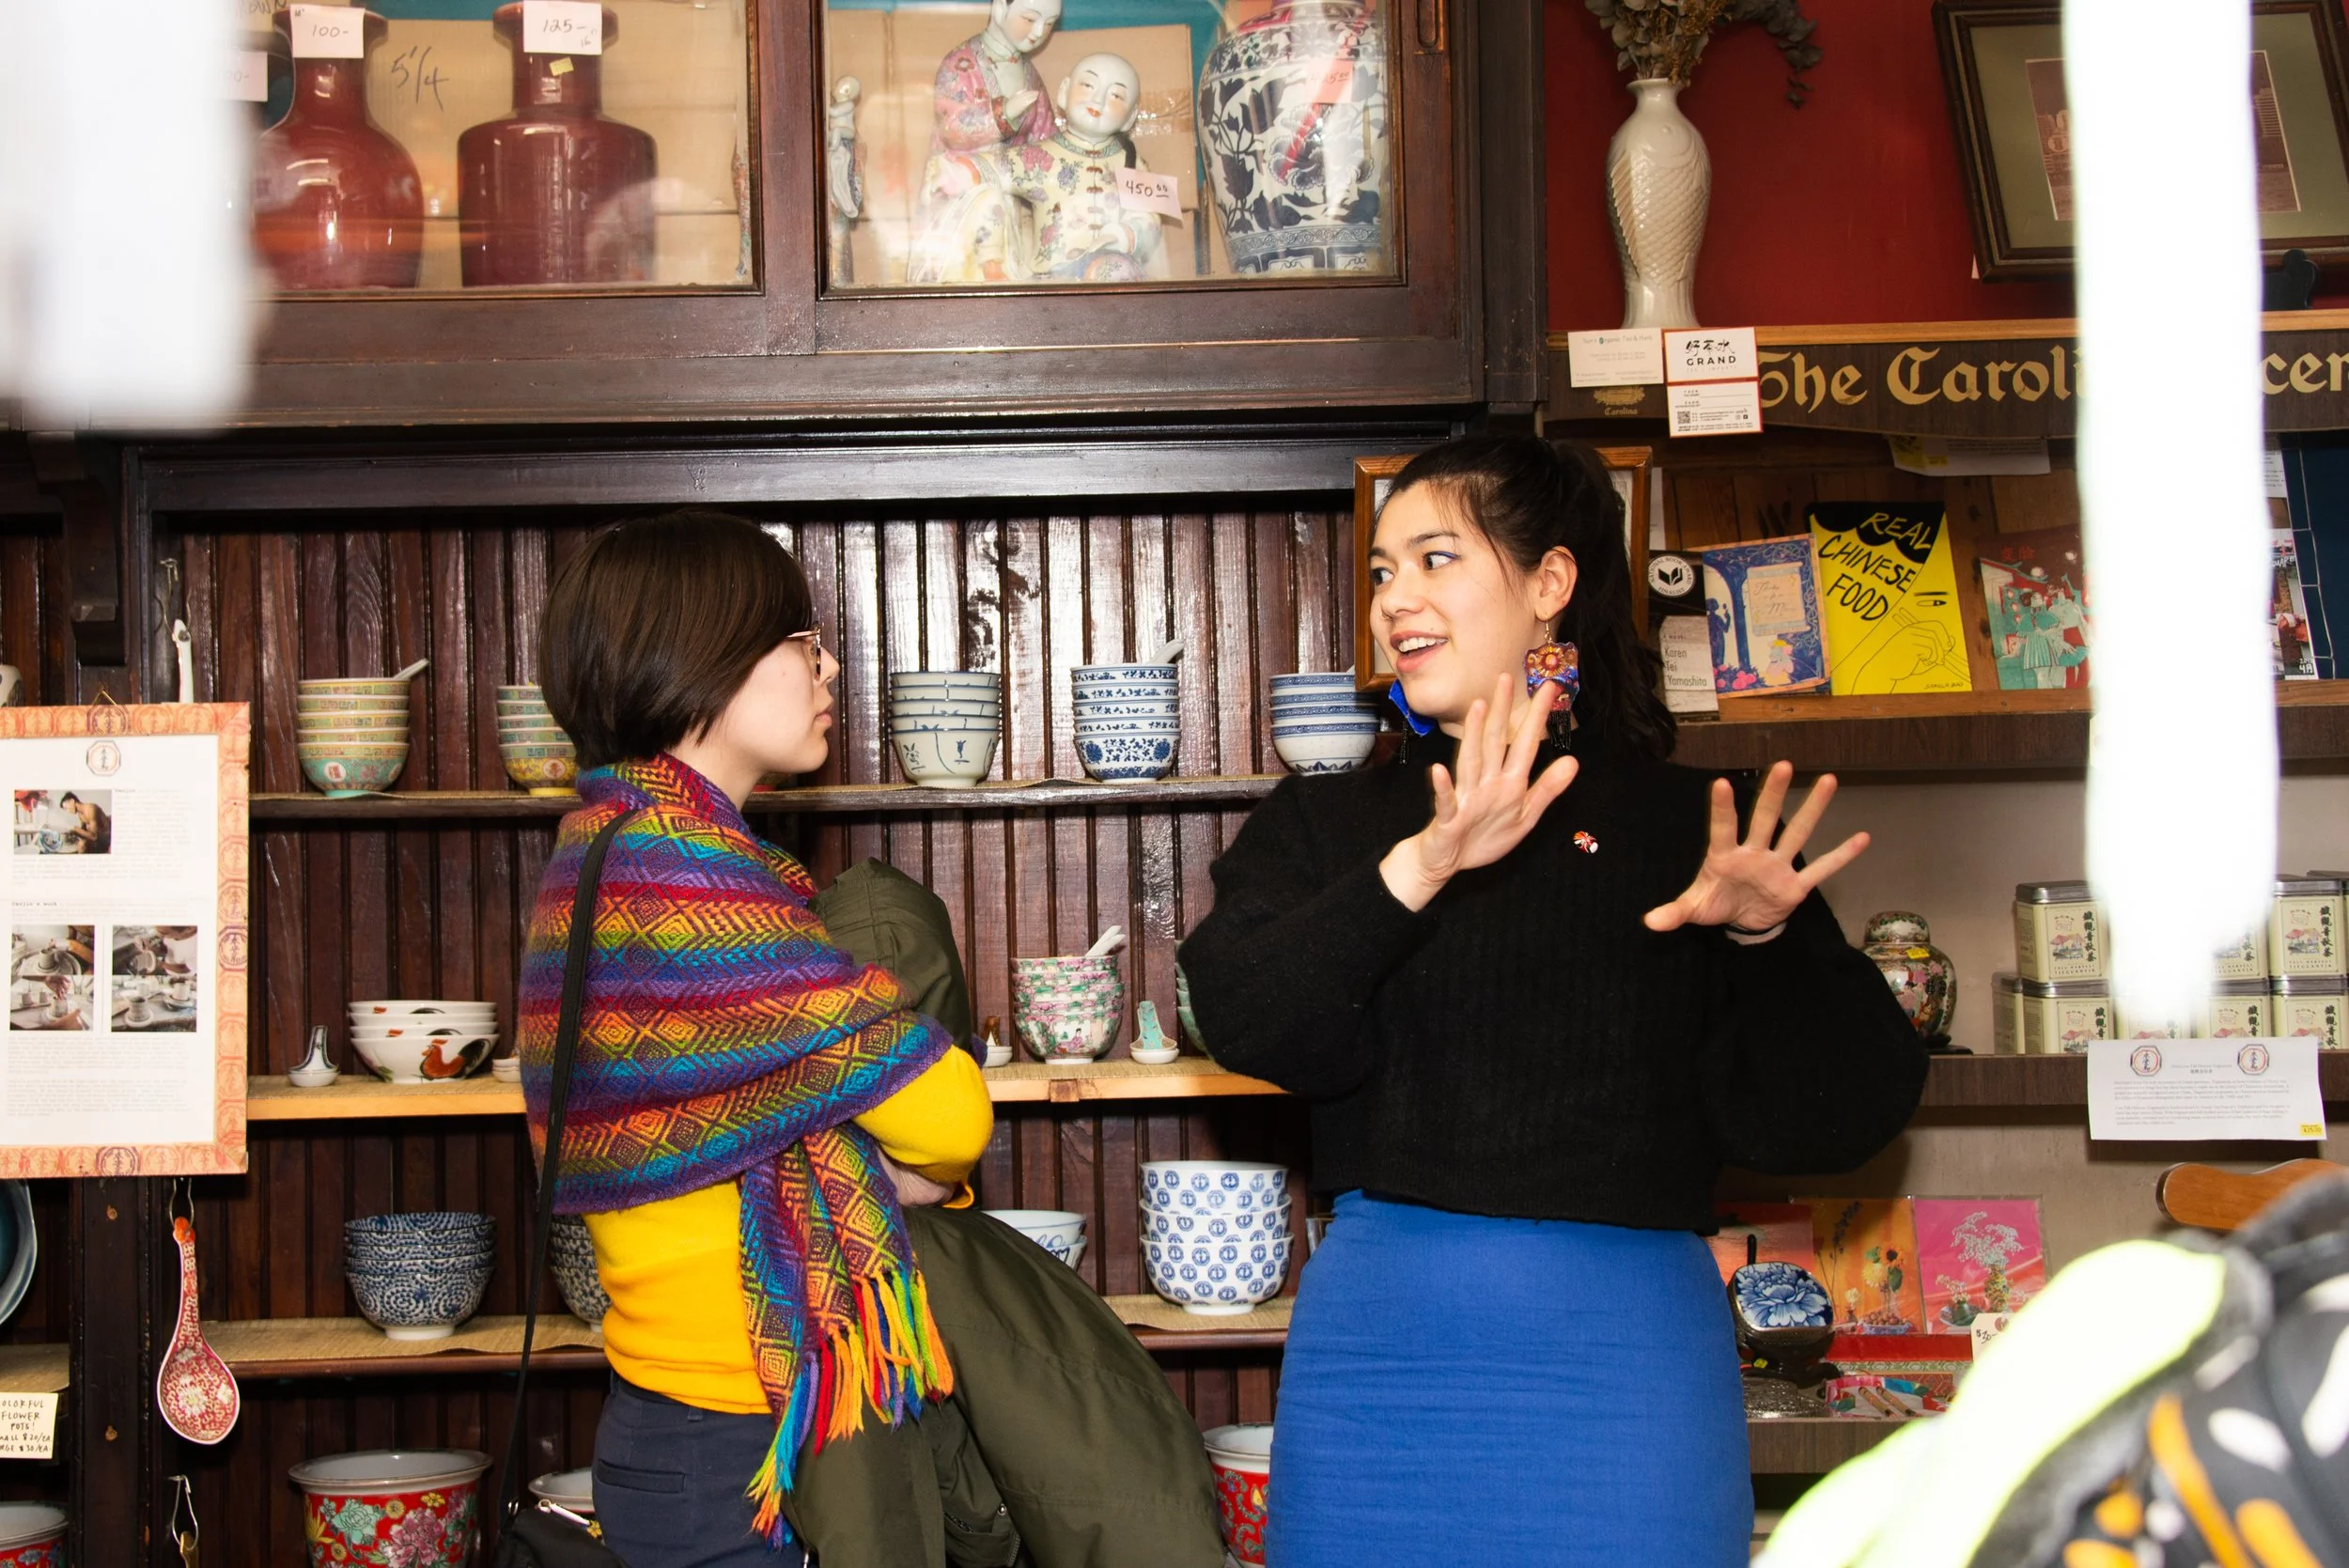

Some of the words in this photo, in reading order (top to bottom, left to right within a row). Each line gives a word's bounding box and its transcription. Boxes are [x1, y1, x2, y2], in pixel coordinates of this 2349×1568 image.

[1686, 355, 1736, 366] GRAND
[1758, 350, 1868, 413] The
[1859, 512, 1931, 550] REAL
[1819, 535, 1917, 594] CHINESE
[1827, 573, 1889, 621] FOOD
[1664, 646, 1688, 659] Karen
[1666, 660, 1678, 672] Tei
[1666, 674, 1707, 687] Yamashita
[1, 1399, 43, 1408] OLORFUL
[1, 1411, 40, 1421] FLOWER
